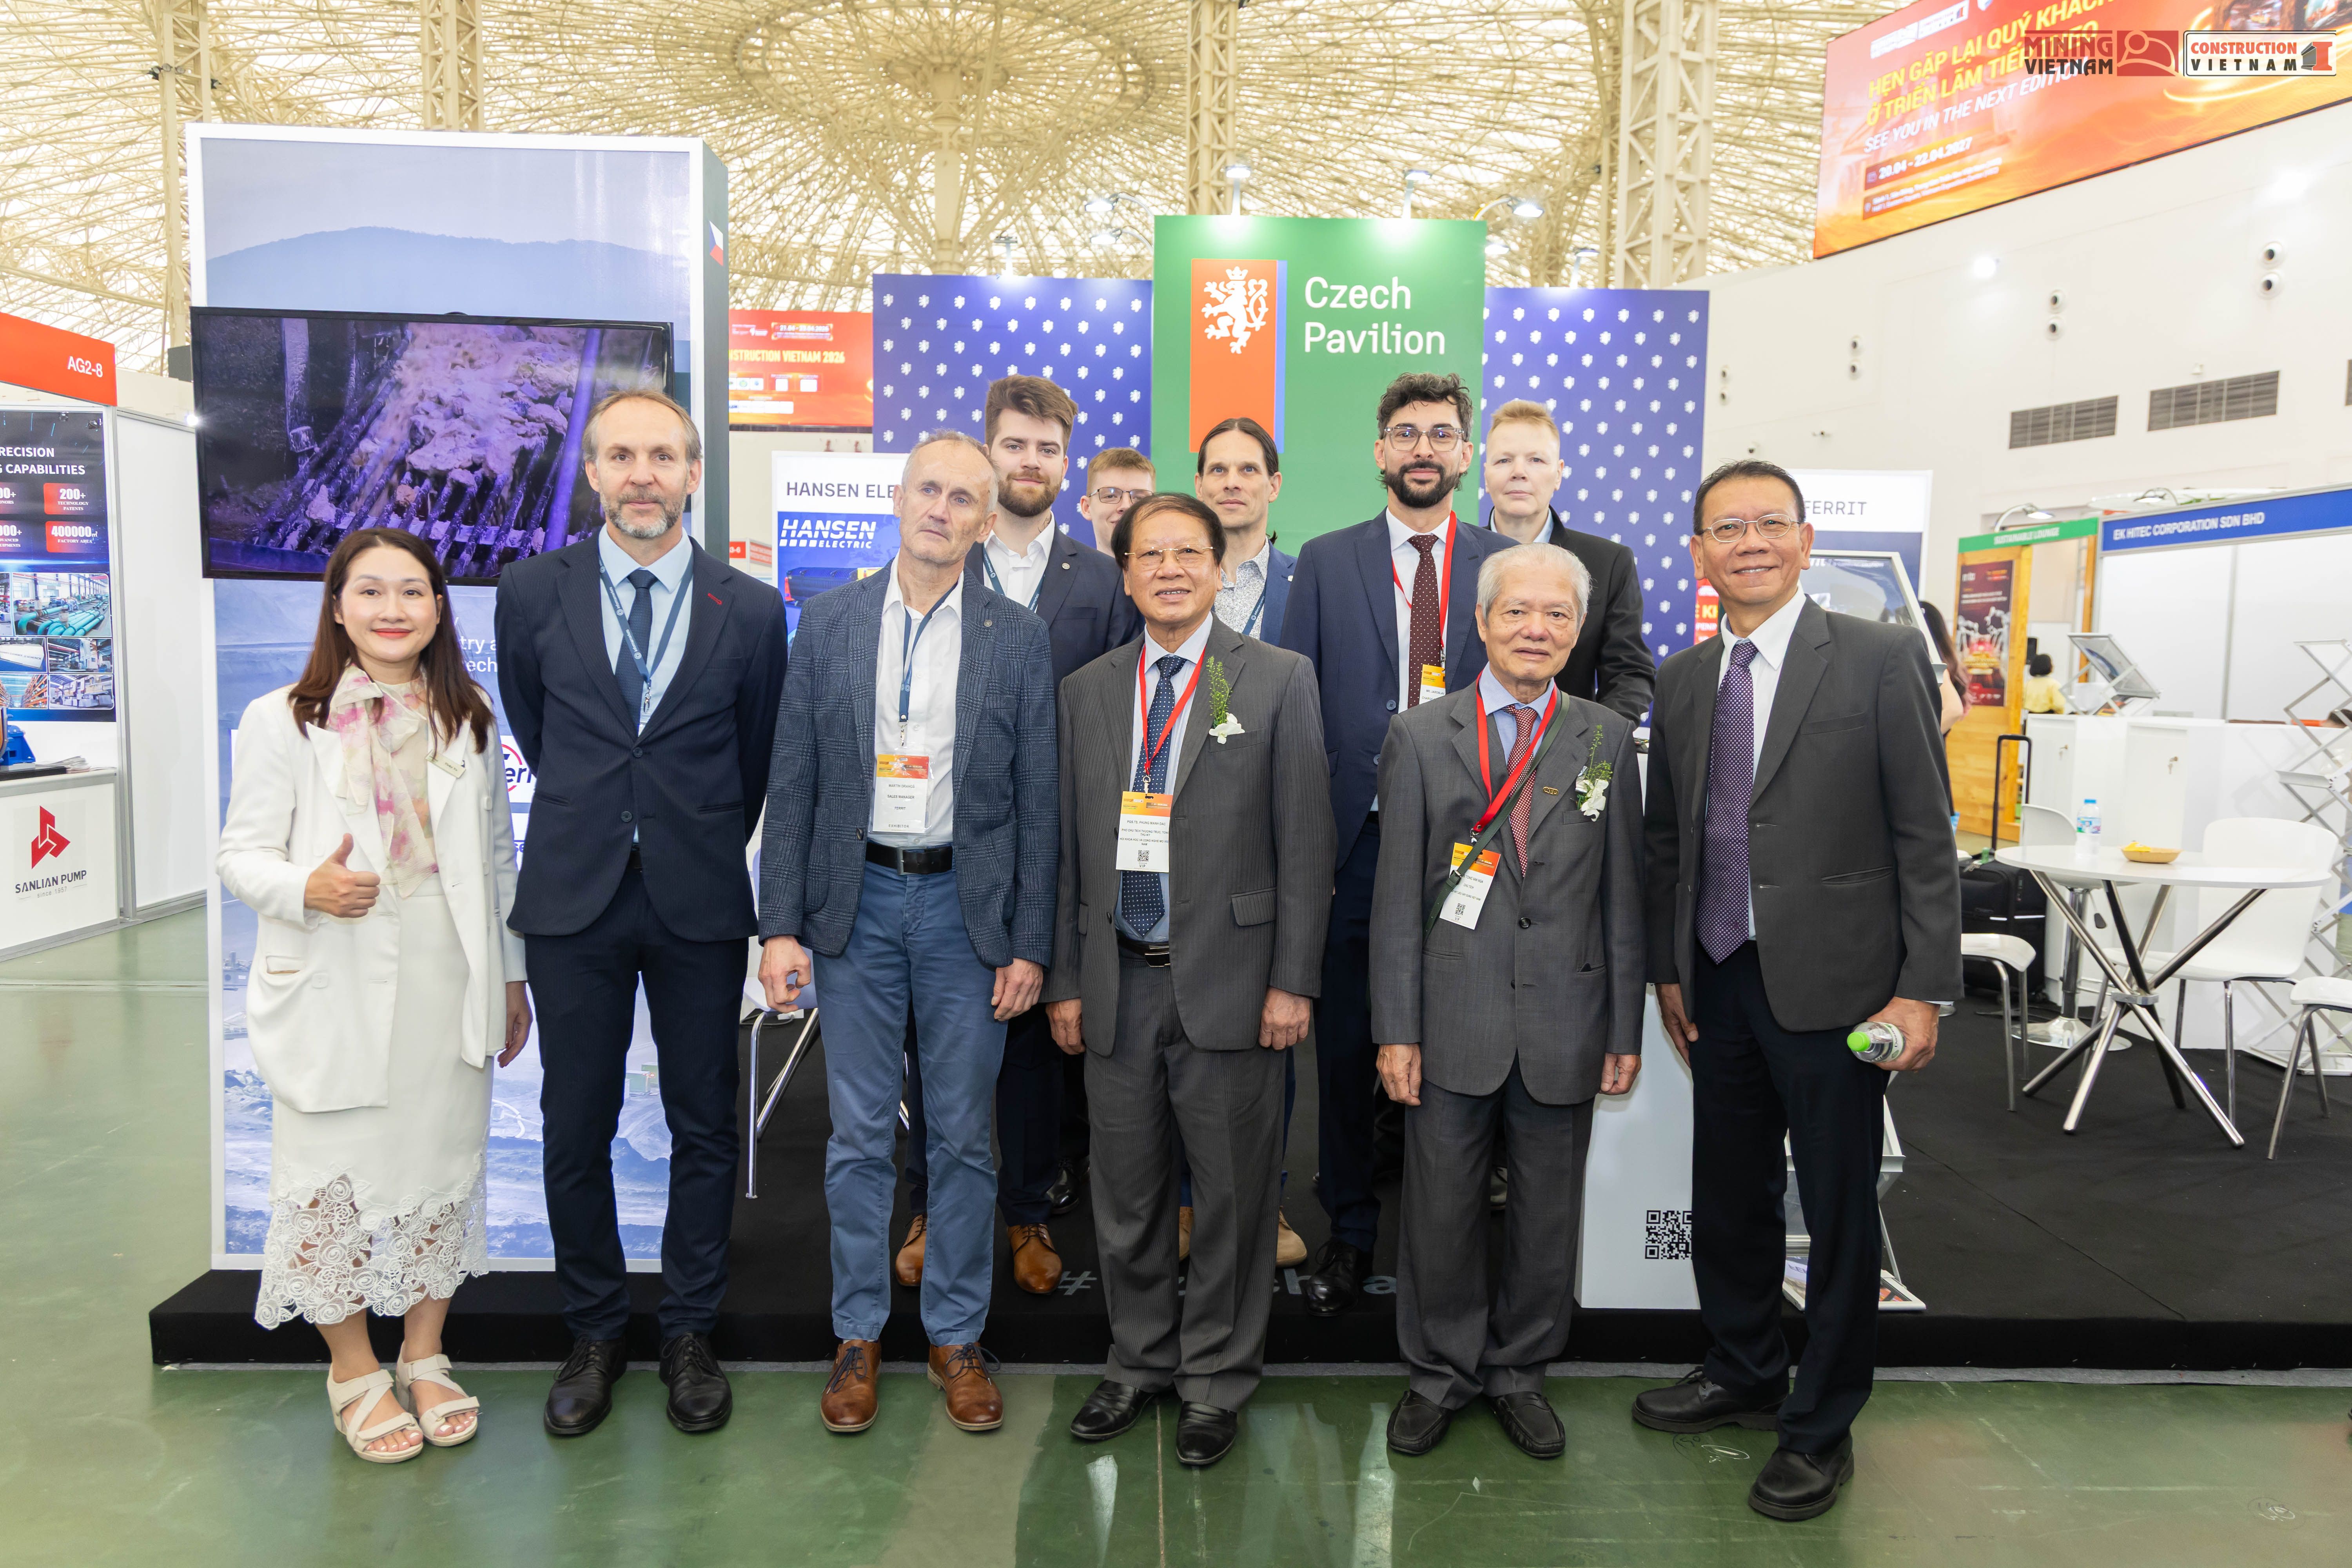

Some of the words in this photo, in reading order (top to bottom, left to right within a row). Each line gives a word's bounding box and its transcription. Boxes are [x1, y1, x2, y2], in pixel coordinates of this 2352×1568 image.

[1868, 67, 1905, 98] HẸN
[1909, 50, 1948, 82] GẶP
[1951, 34, 1983, 65] LẠI
[1987, 13, 2032, 49] QUÝ
[1866, 101, 1883, 126] Ở
[1885, 80, 1937, 120] TRIỂN
[1941, 67, 1981, 99] LÃM
[1864, 130, 1890, 152] SEE
[1893, 121, 1921, 142] YOU
[1923, 112, 1939, 131] IN
[1944, 100, 1973, 123] THE
[1974, 82, 2020, 113] NEXT
[1879, 160, 1907, 180] 20.04
[1305, 276, 1411, 310] Czech
[1305, 321, 1445, 355] Pavilion
[67, 356, 103, 377] AG2-8
[782, 350, 821, 363] VIETNAM
[822, 351, 845, 363] 2026
[5, 464, 85, 475] CAPABILITIES
[59, 488, 86, 500] 200+
[787, 482, 858, 497] HANSEN
[1804, 501, 1867, 515] FERRIT
[781, 519, 877, 539] HANSEN
[2113, 528, 2126, 540] EK
[2126, 525, 2152, 539] HITEC
[2152, 517, 2219, 536] CORPORATION
[2219, 515, 2241, 528] SDN
[2242, 512, 2265, 526] BHD
[819, 540, 873, 549] ELECTRIC
[15, 876, 58, 893] SANLIAN
[61, 870, 87, 884] PUMP
[37, 890, 52, 898] since
